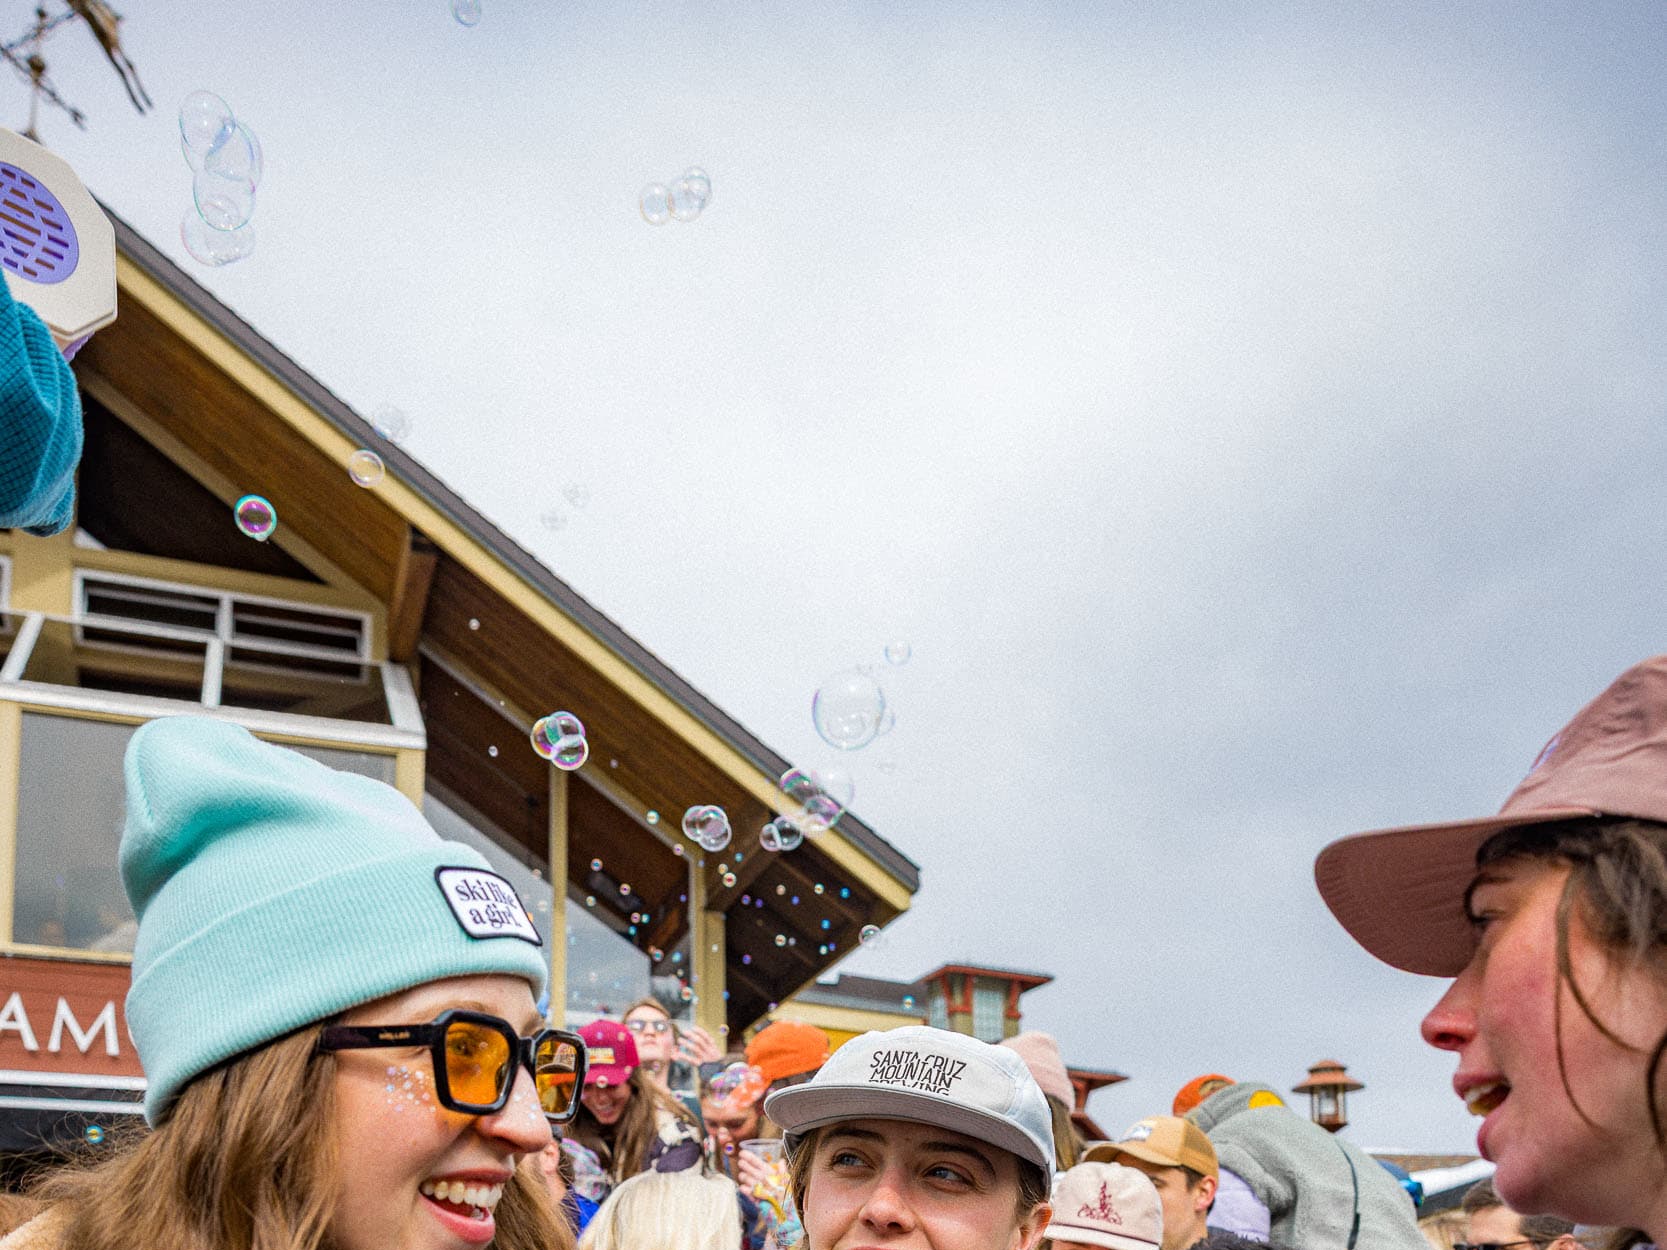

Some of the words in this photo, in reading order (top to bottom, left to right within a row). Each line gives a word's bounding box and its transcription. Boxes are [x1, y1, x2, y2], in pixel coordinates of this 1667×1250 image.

[455, 879, 490, 901] ski
[469, 909, 486, 925] a
[485, 903, 522, 928] girl
[870, 1050, 919, 1068] SANTA
[870, 1058, 953, 1088] MOUNTAIN
